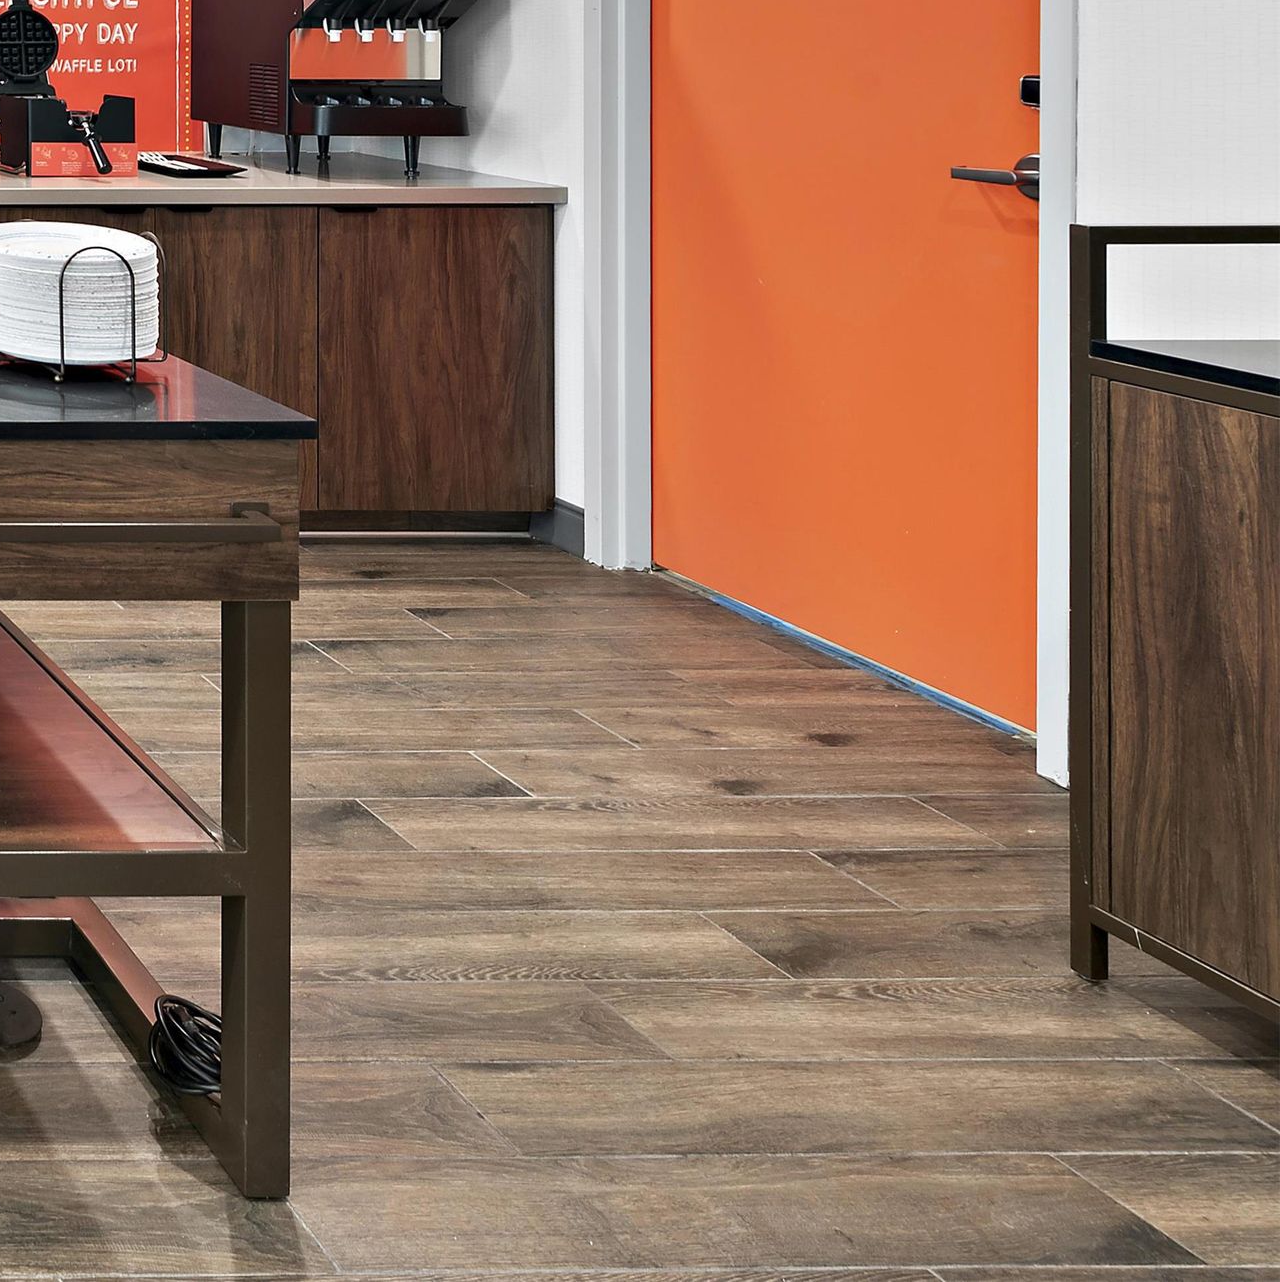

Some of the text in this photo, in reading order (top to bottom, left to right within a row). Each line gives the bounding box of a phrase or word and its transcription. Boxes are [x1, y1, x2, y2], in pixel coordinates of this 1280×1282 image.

[96, 23, 139, 45] DAY
[51, 59, 102, 73] WAFFLE
[107, 58, 138, 72] LOT!
